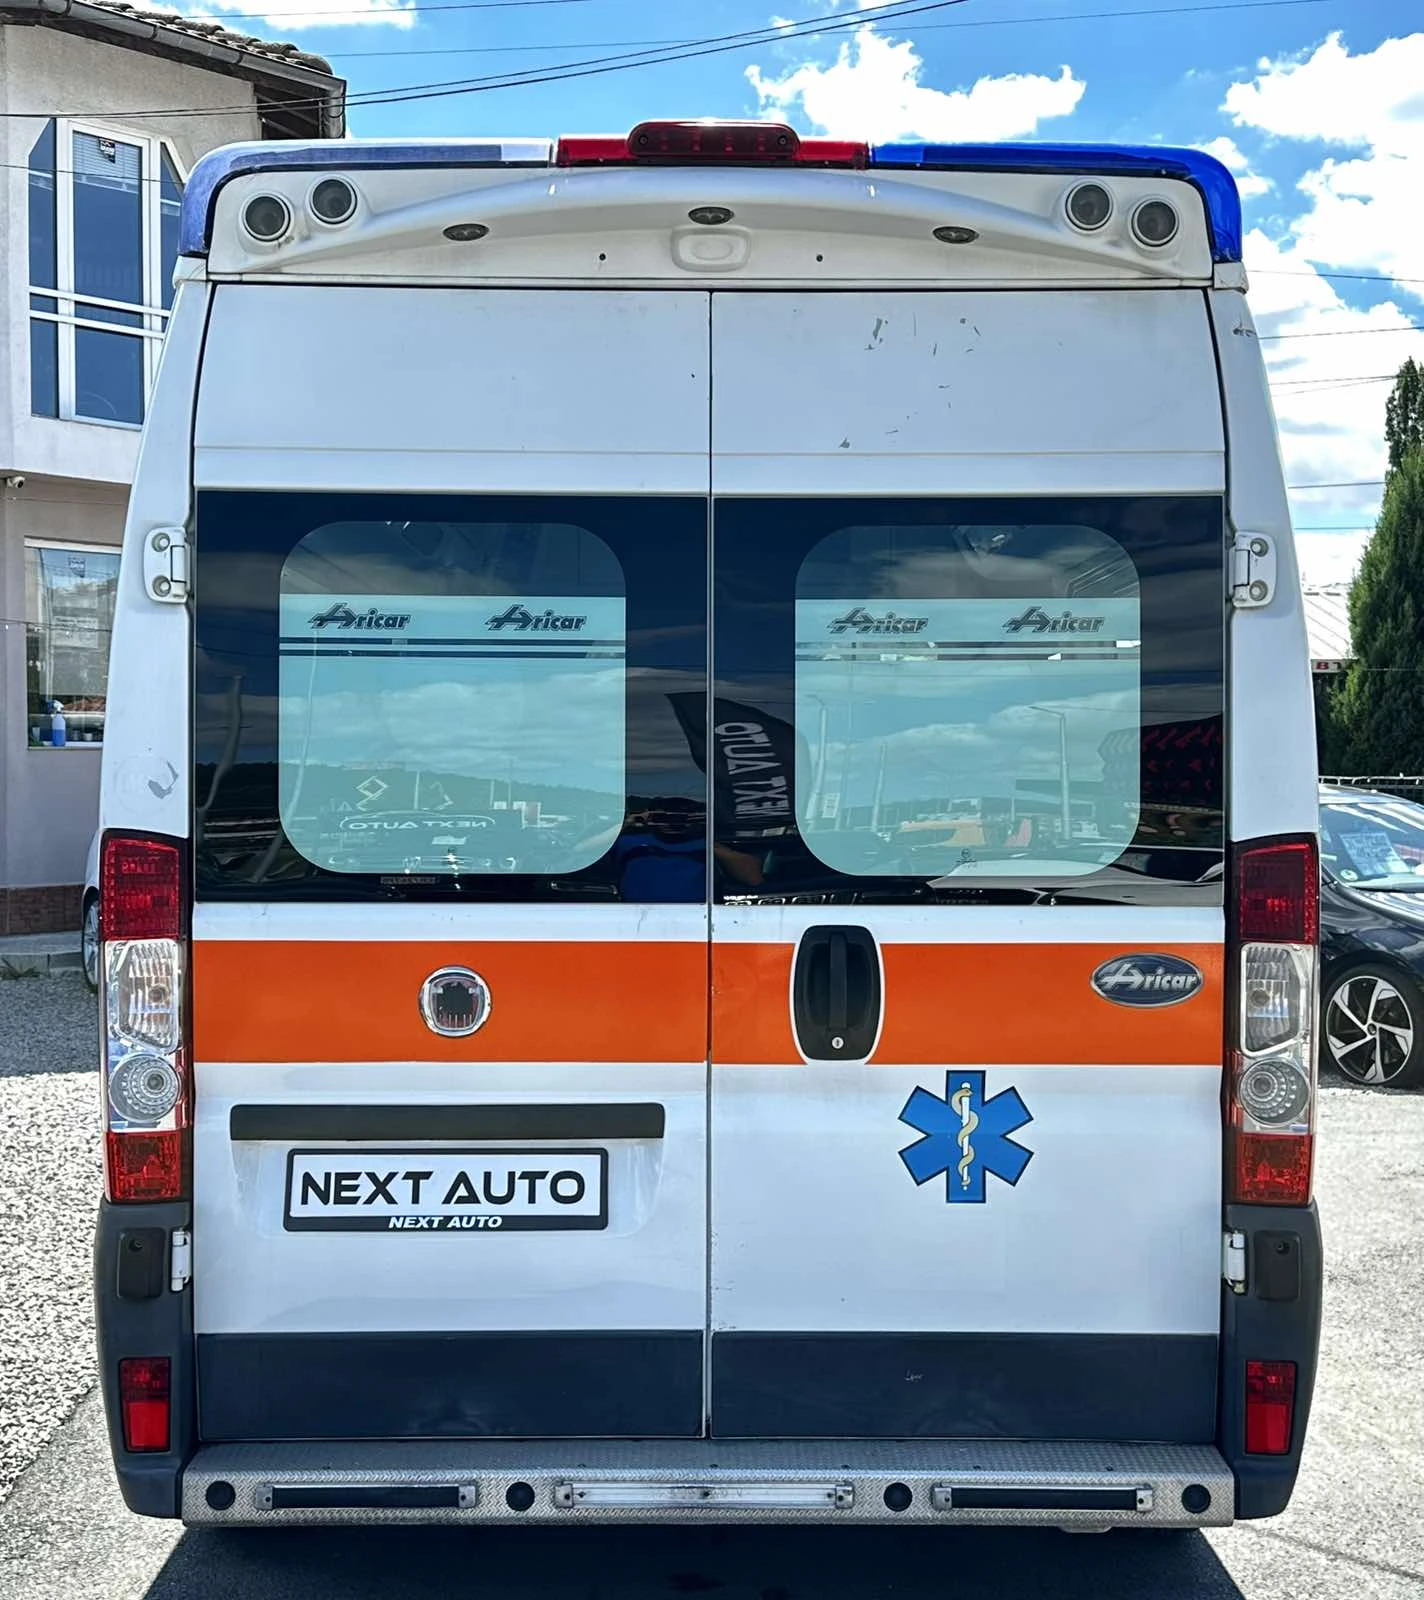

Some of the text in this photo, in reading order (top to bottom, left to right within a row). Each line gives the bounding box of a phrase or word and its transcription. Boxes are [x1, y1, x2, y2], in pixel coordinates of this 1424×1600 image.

[307, 602, 411, 630] Aricar
[484, 603, 587, 631] Aricar
[826, 606, 928, 634] Aricar
[1001, 606, 1105, 634] Aricar
[1099, 962, 1197, 990] Aricar
[300, 1170, 586, 1206] NEXT AUTO
[388, 1215, 502, 1229] NEXT AUTO
